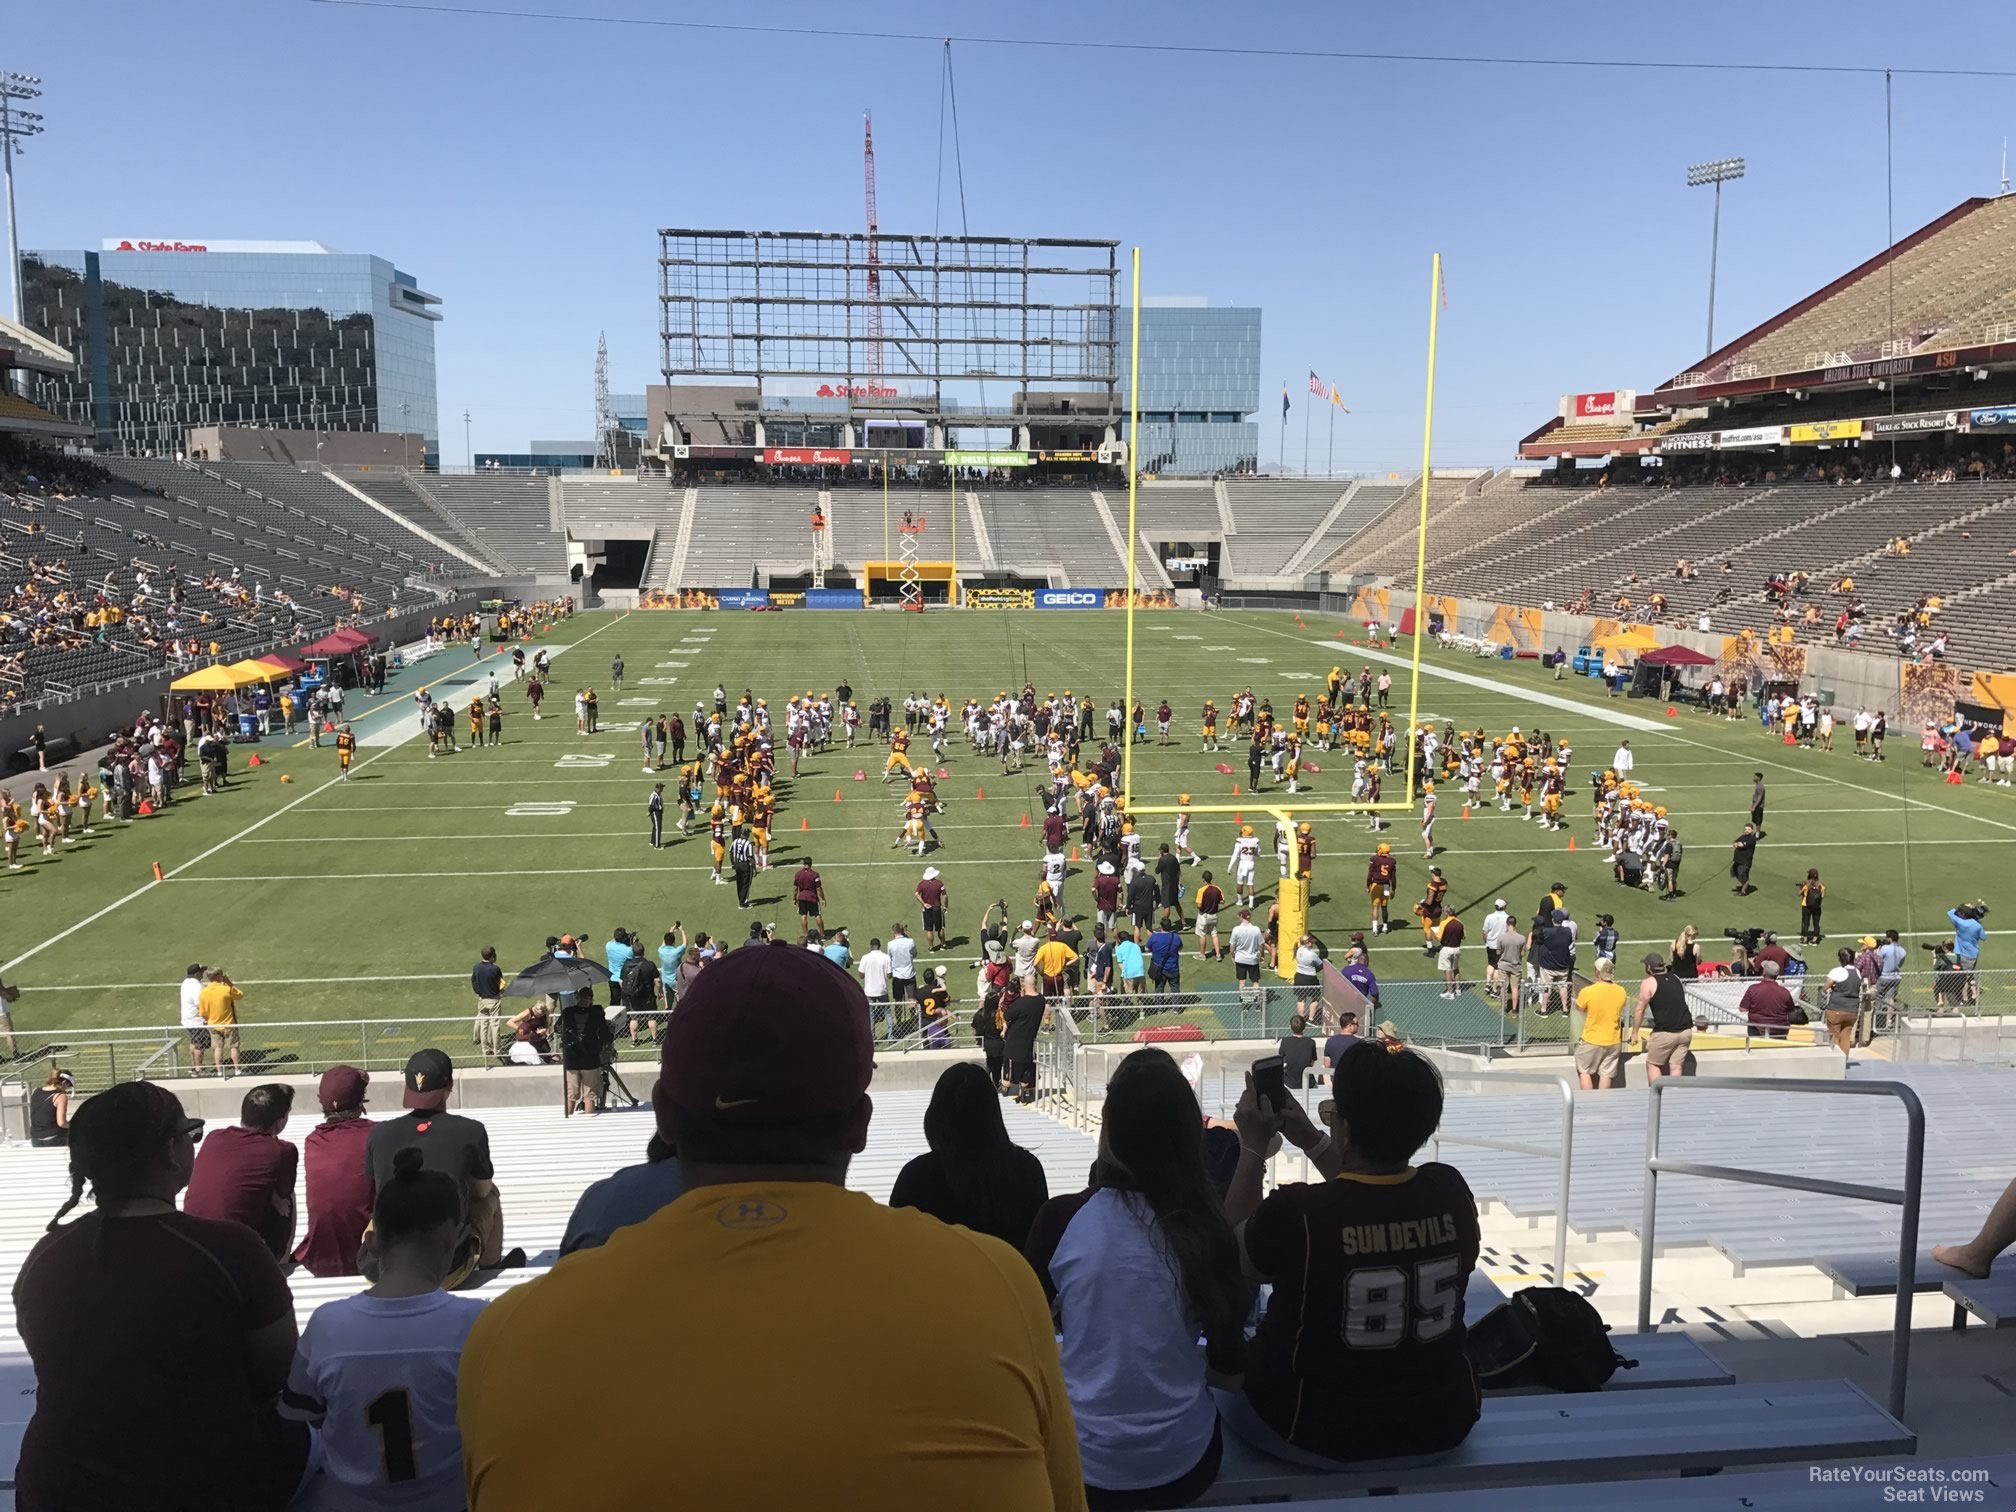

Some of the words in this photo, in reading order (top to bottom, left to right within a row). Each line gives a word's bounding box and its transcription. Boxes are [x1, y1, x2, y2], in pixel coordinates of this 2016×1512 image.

[1936, 352, 1957, 368] ASU
[1823, 369, 1851, 383] ARIZONA
[1852, 364, 1871, 379] STATE
[868, 385, 897, 398] Farm
[1667, 440, 1713, 450] FITNESS
[960, 456, 988, 464] DELTA
[989, 456, 1024, 465] DENTAL
[1043, 593, 1096, 605] GEICO
[1963, 720, 2003, 731] NEWORKS
[1241, 846, 1256, 856] 23
[1053, 863, 1061, 874] 2
[1380, 865, 1389, 876] 5
[924, 998, 936, 1016] 2
[1342, 1225, 1387, 1255] SUN
[1389, 1213, 1457, 1251] DEVILS
[1341, 1253, 1462, 1349] 85
[364, 1386, 417, 1482] 1
